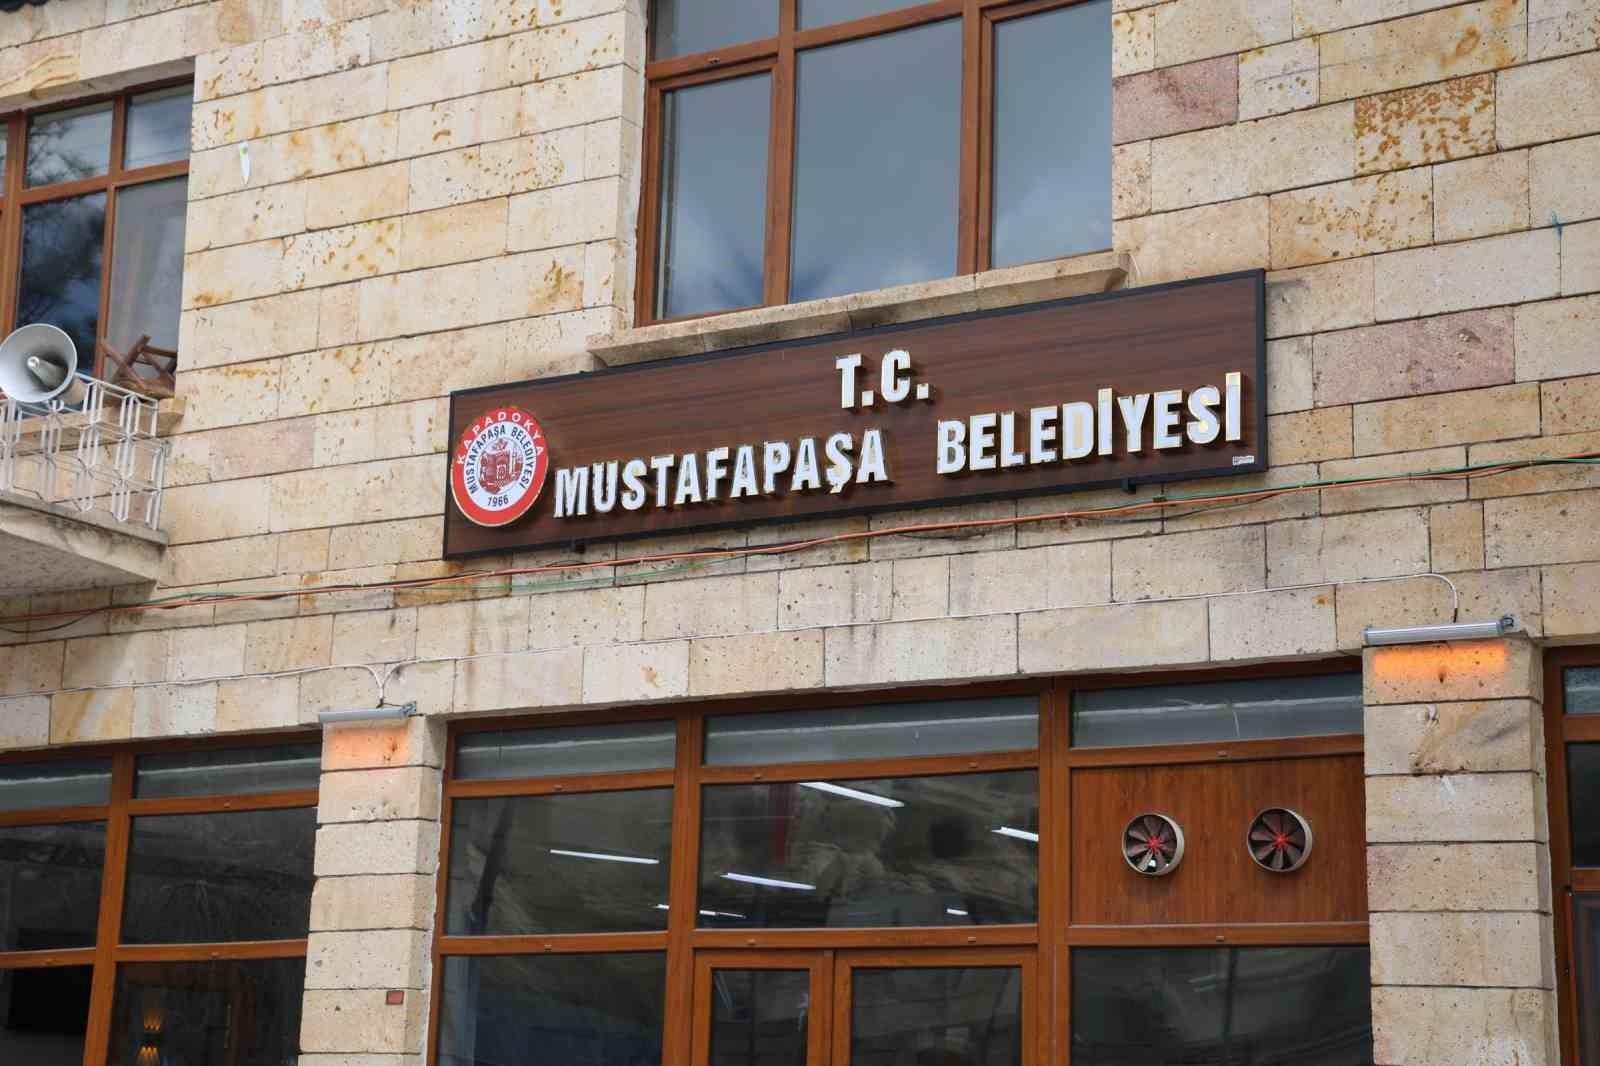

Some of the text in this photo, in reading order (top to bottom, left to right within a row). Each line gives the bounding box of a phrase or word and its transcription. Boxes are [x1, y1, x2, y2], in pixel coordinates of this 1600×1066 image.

[835, 350, 930, 409] T.C.
[457, 411, 544, 465] KAPADOKYA
[553, 371, 1242, 518] MUSTAFAPAŞA BELEDİYESİ
[487, 494, 509, 507] 1966
